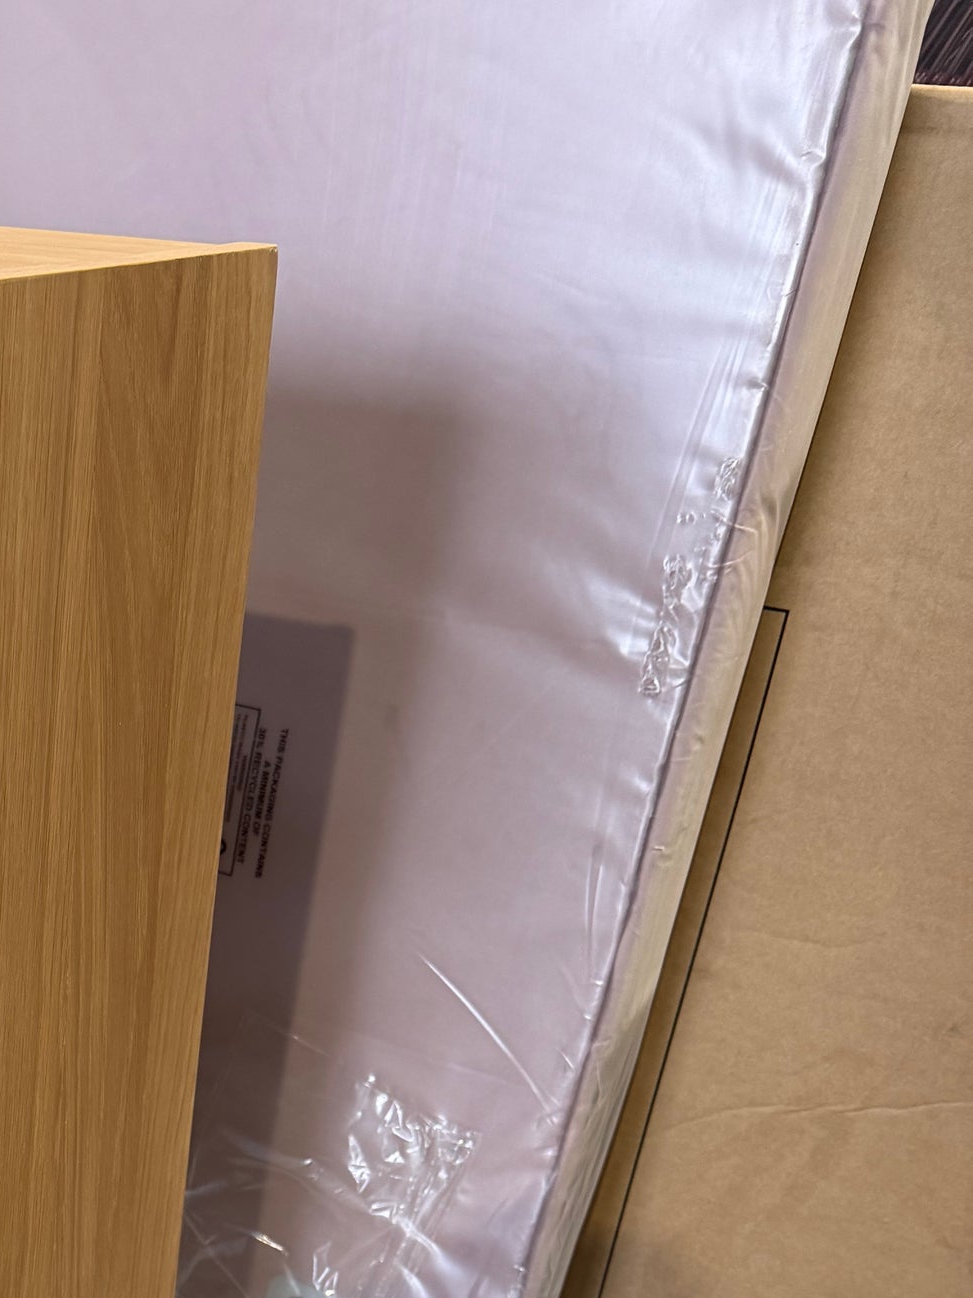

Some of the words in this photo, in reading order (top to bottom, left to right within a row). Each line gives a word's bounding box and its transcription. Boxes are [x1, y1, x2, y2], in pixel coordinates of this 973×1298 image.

[276, 728, 289, 753] THIS
[245, 752, 262, 812] RECYCLED
[254, 771, 270, 819] MINIMUM
[265, 756, 283, 821] PACKAGING
[237, 813, 252, 864] CONTENT
[253, 821, 261, 836] OF
[255, 823, 271, 879] CONTAINS
